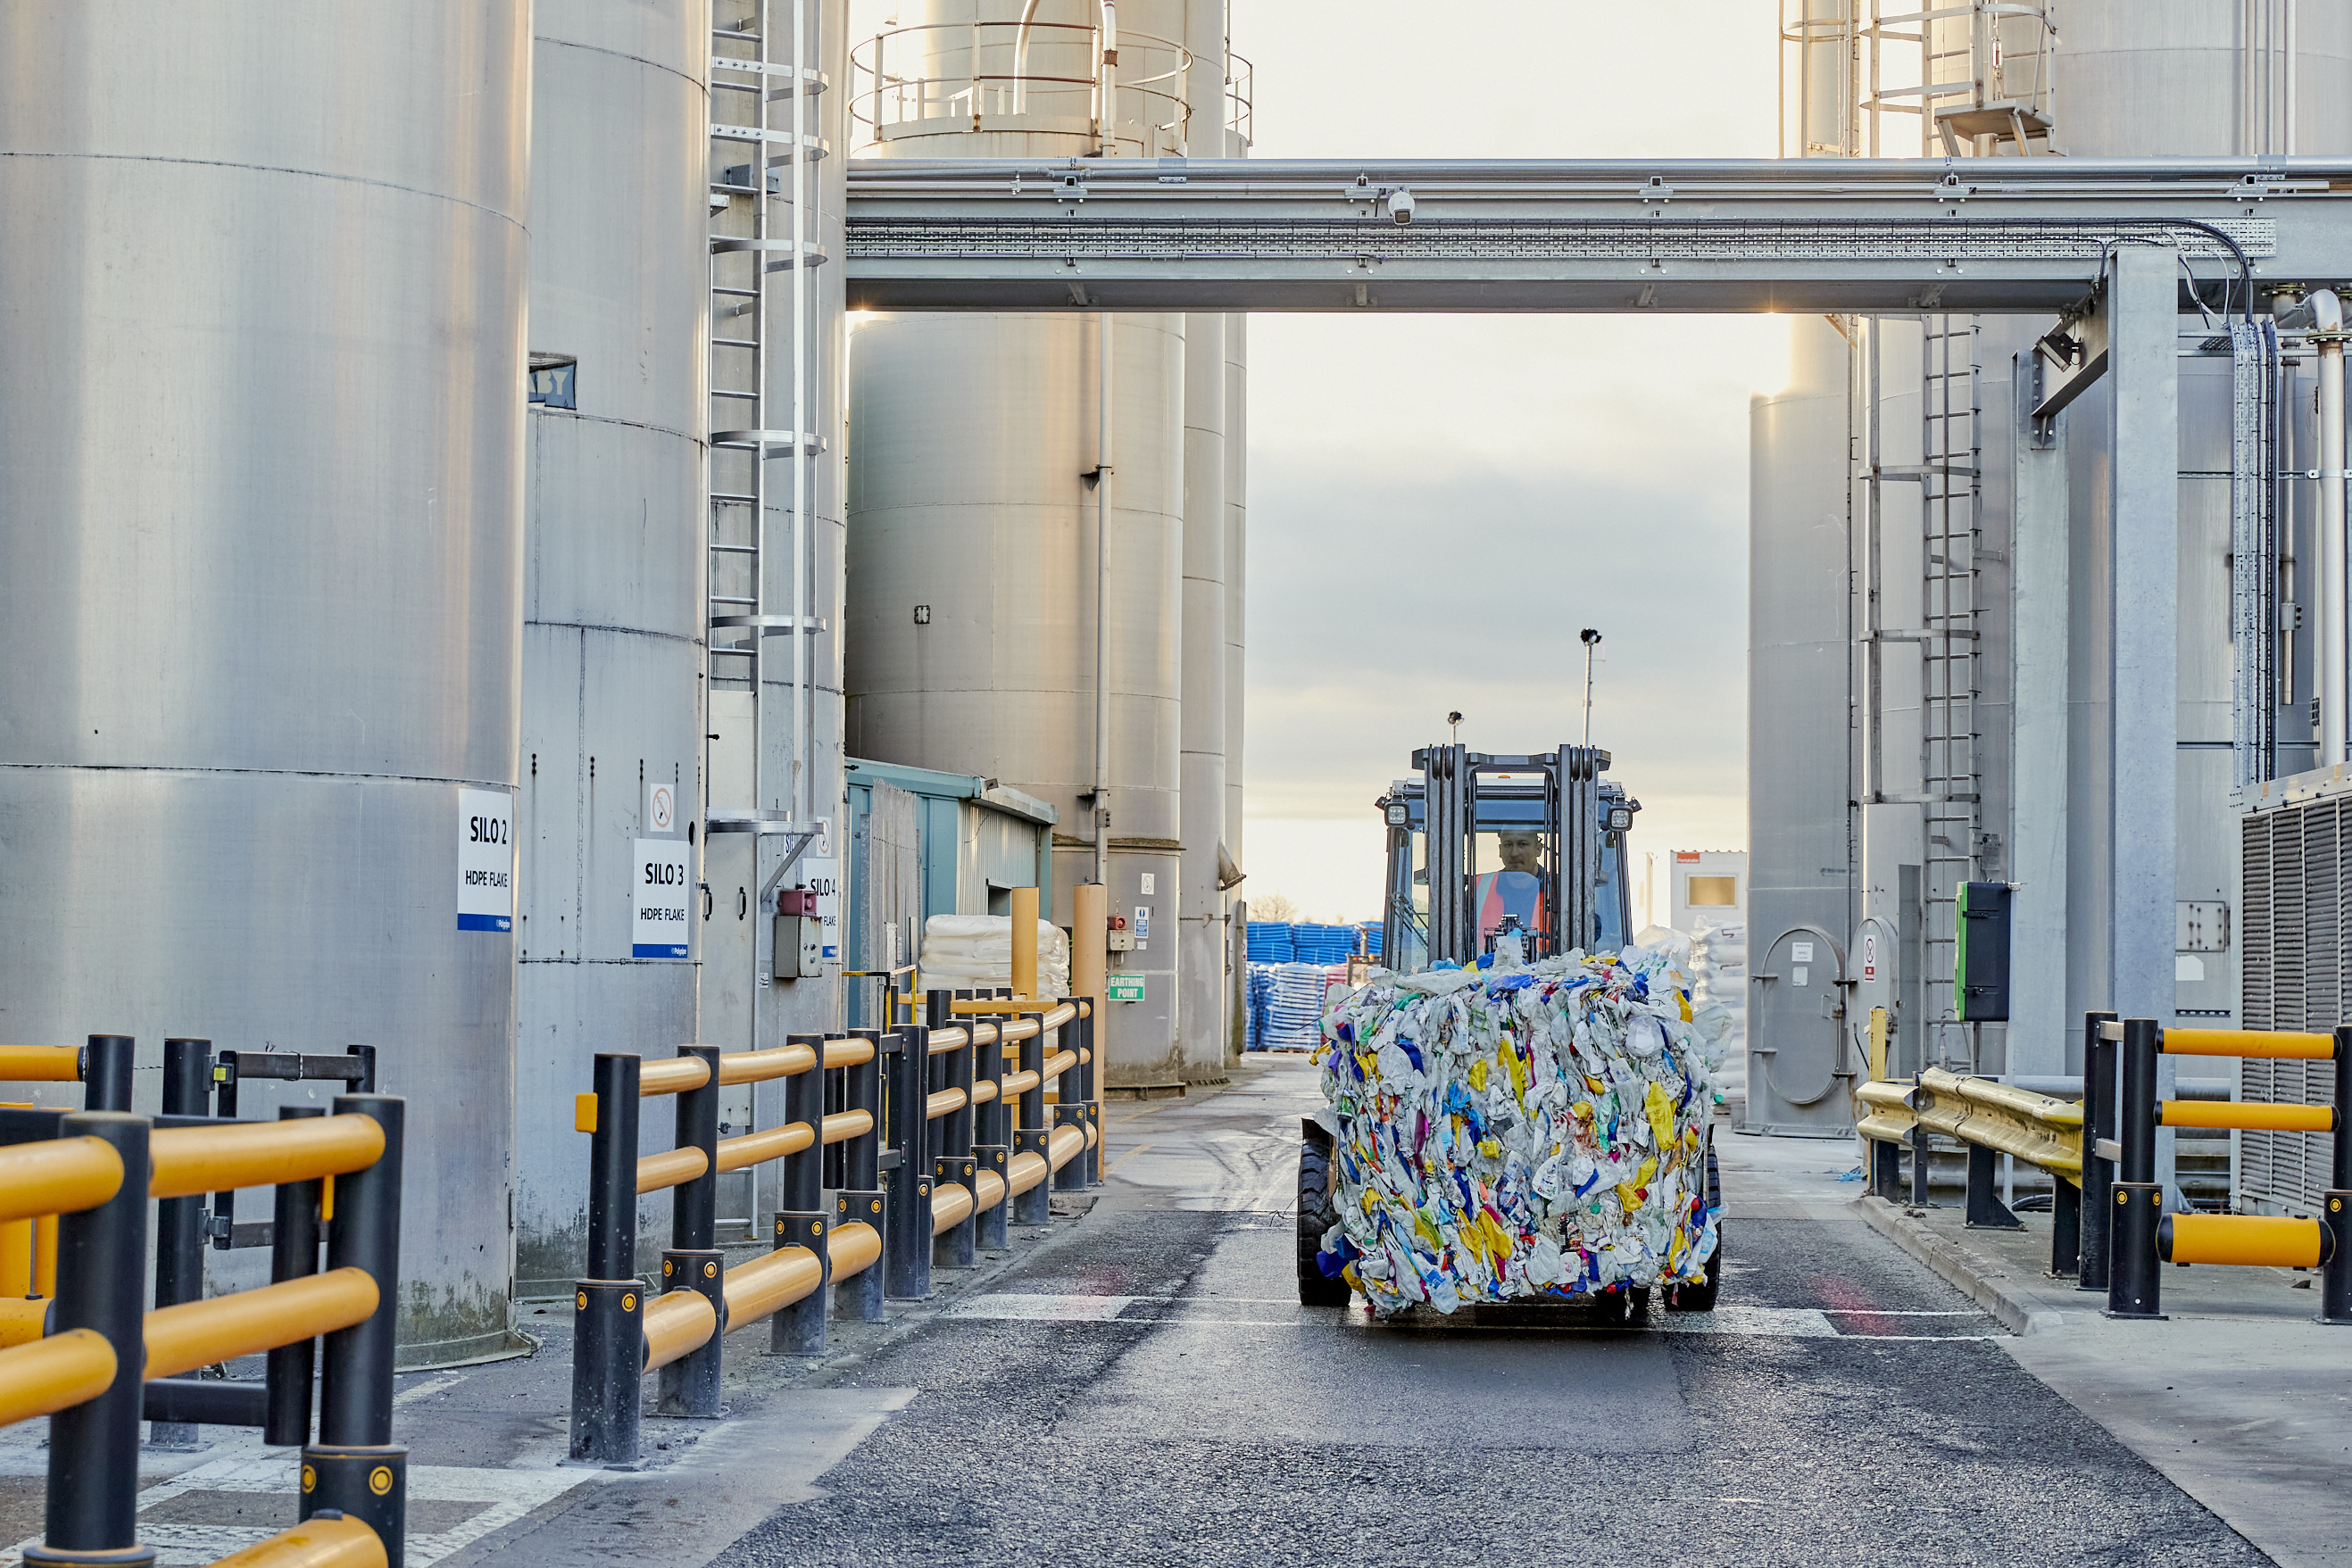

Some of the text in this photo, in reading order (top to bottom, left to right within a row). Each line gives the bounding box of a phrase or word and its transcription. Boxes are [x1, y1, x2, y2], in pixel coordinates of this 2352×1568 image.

[470, 816, 507, 845] SILO 2
[466, 870, 507, 888] HDPE FLAKE
[645, 863, 684, 886] SILO 3
[810, 878, 835, 897] SILO 4
[641, 908, 685, 921] HDPE FLAKE
[823, 916, 836, 926] FLAKE
[1110, 976, 1143, 987] EARTHING
[1117, 988, 1138, 998] POINT
